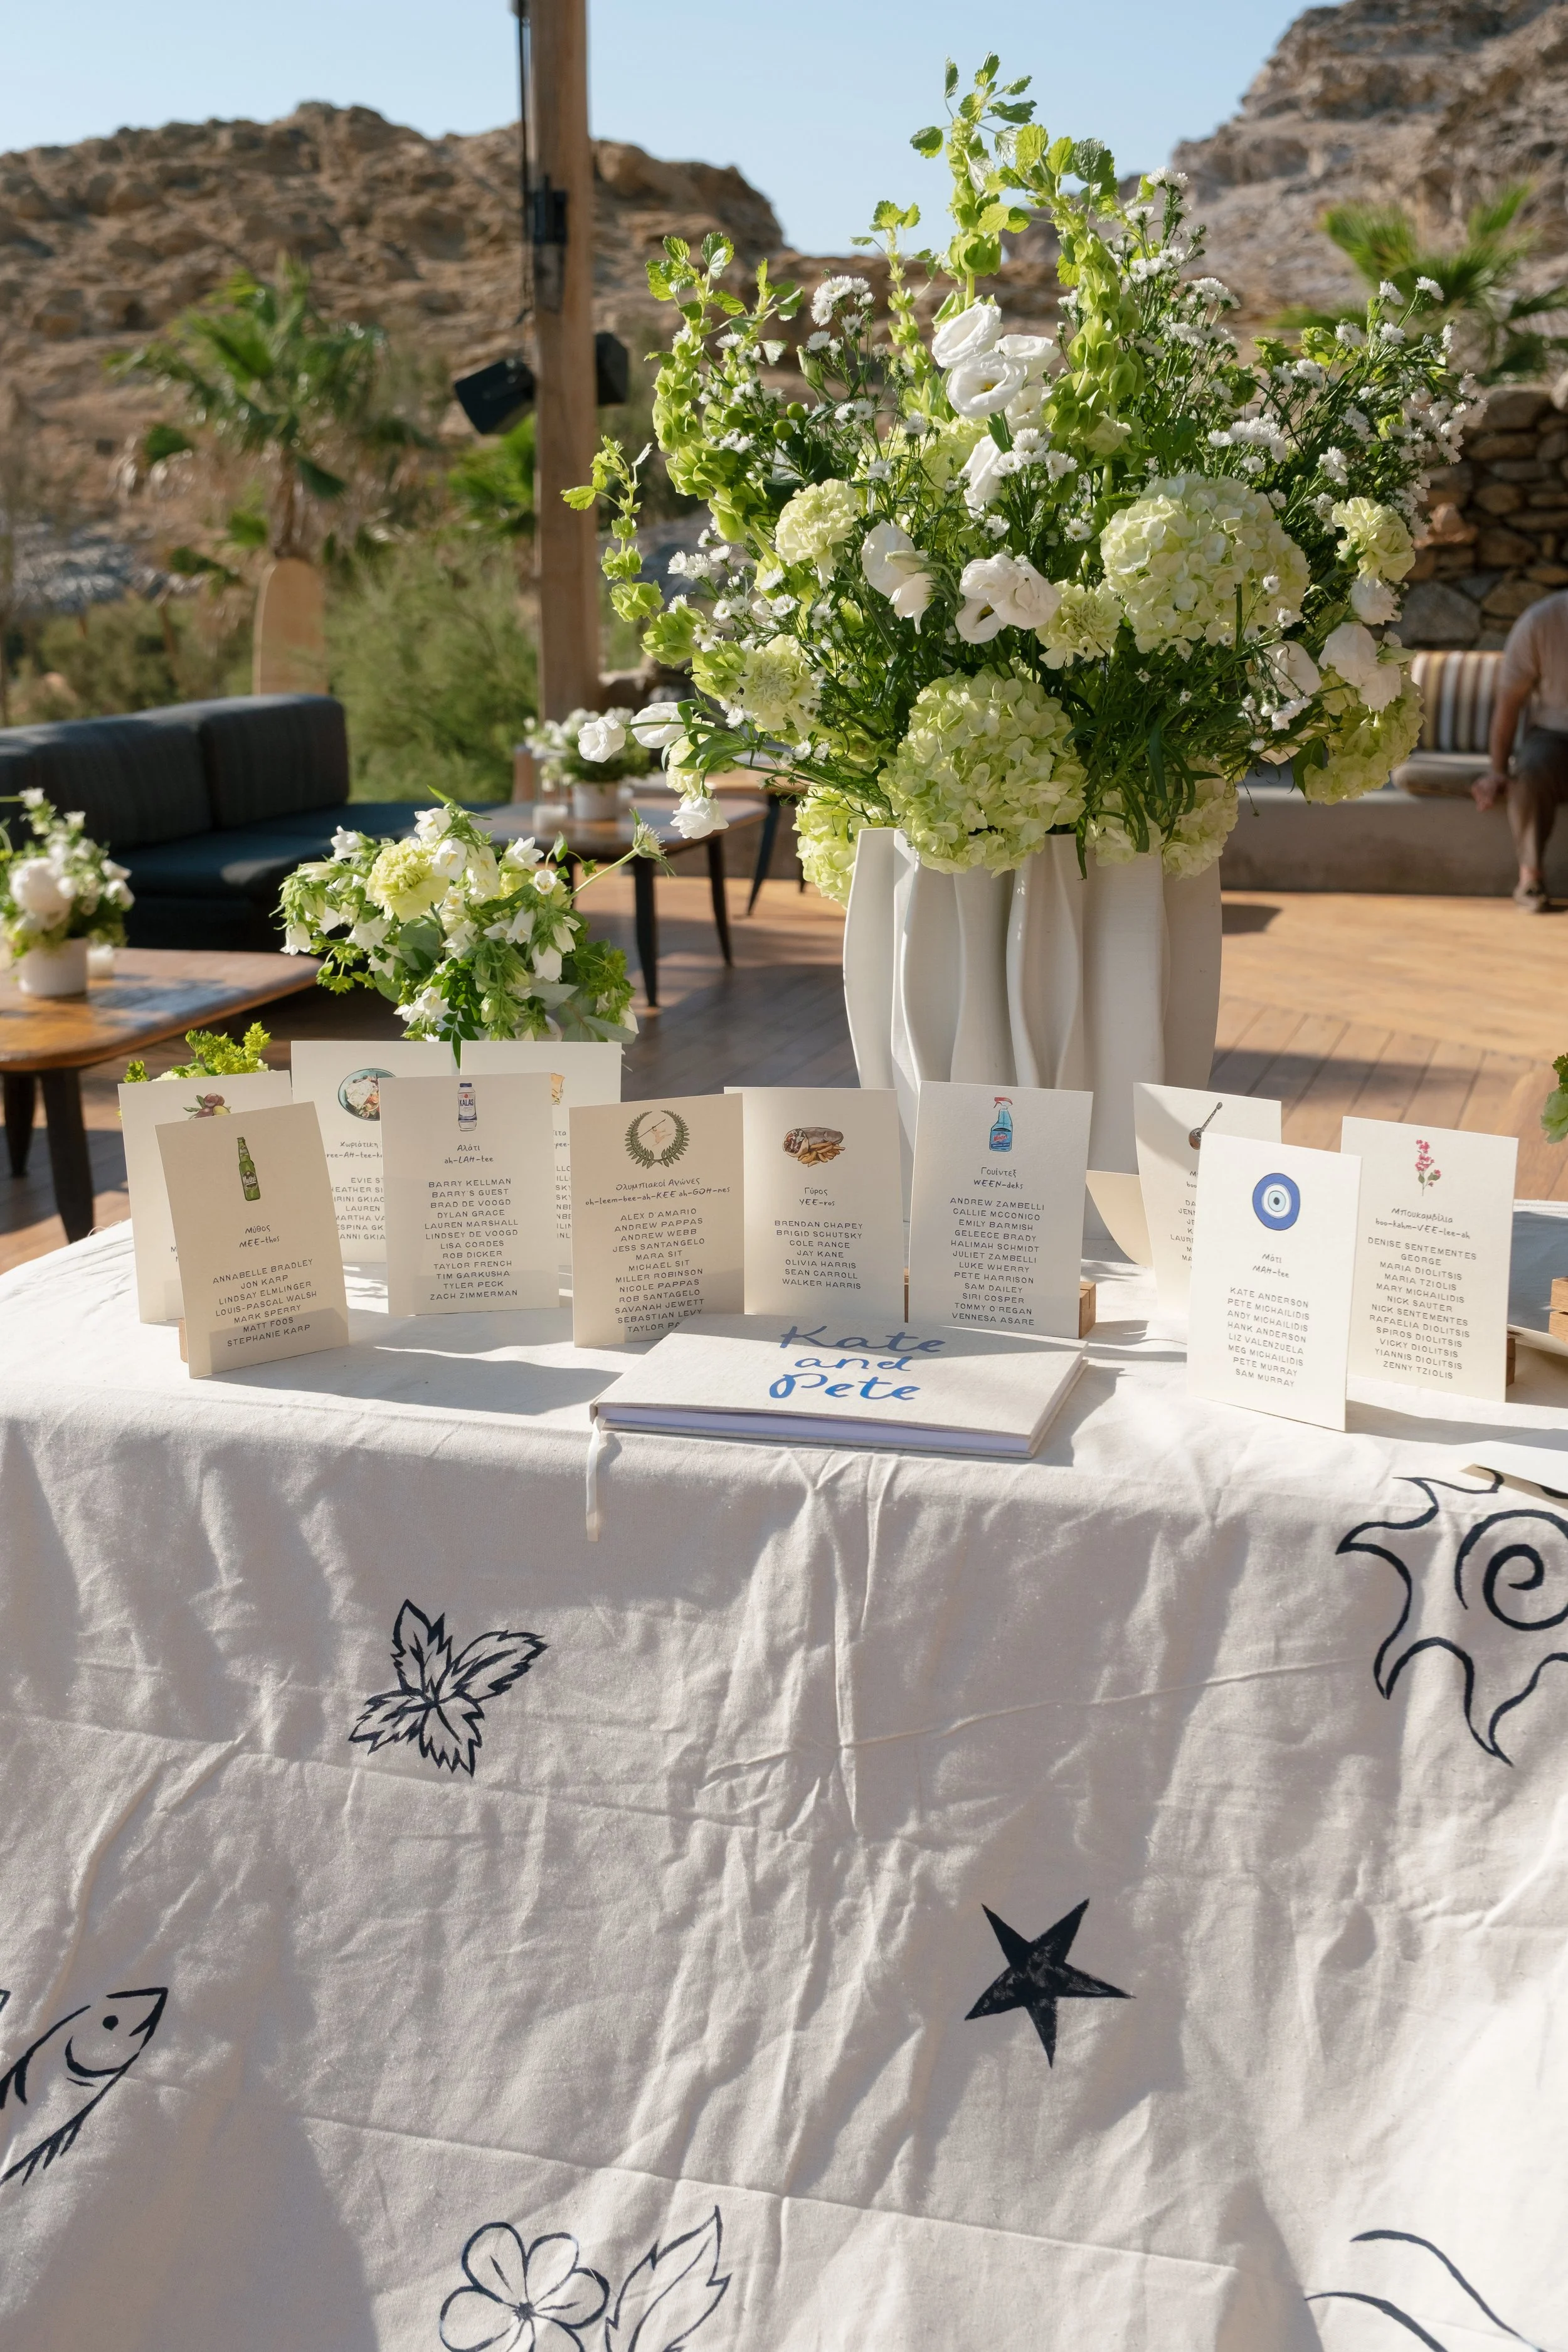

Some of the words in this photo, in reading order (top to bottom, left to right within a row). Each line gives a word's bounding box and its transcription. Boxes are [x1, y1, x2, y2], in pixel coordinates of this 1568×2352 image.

[444, 1155, 494, 1164] ah-LAH-tee
[466, 1178, 511, 1186] KELLMAN
[973, 1179, 1023, 1189] WEEN-deks
[432, 1190, 475, 1198] BARRY'S
[950, 1197, 993, 1206] ANDREW
[996, 1200, 1044, 1210] ZAMBELLI
[620, 1213, 645, 1221] ALEX
[649, 1208, 696, 1218] D'AMARIO
[953, 1208, 987, 1216] CALLIE
[990, 1211, 1040, 1221] MCCONICO
[425, 1221, 462, 1229] LAUREN
[467, 1219, 518, 1227] MARSHALL
[615, 1222, 657, 1232] ANDREW
[661, 1217, 702, 1227] PAPPAS
[989, 1221, 1033, 1231] BARMISH
[621, 1232, 664, 1242] ANDREW
[667, 1229, 697, 1237] WEBB
[813, 1231, 862, 1239] SCHUTSKY
[955, 1229, 999, 1239] GELEECE
[1003, 1233, 1036, 1242] BRADY
[239, 1236, 280, 1248] MEE-thos
[465, 1240, 504, 1248] CORDES
[613, 1244, 637, 1253] JESS
[640, 1238, 704, 1250] SANTANGELO
[1368, 1237, 1401, 1248] DENISE
[1405, 1242, 1476, 1260] SENTEMENTES
[636, 1253, 664, 1261] MARA
[953, 1251, 985, 1259] JULIET
[988, 1253, 1036, 1263] ZAMBELLI
[1401, 1254, 1441, 1266] GEORGE
[213, 1268, 268, 1284] ANNABELLE
[271, 1259, 312, 1273] BRADLEY
[628, 1262, 672, 1271] MICHAEL
[820, 1261, 856, 1269] HARRIS
[959, 1261, 983, 1269] LUKE
[987, 1264, 1029, 1273] WHERRY
[1380, 1261, 1411, 1272] MARIA
[1415, 1267, 1462, 1280] DIOLITSIS
[456, 1271, 510, 1279] GARKUSHA
[616, 1274, 650, 1283] MILLER
[654, 1268, 702, 1279] ROBINSON
[813, 1270, 857, 1279] CARROLL
[954, 1271, 980, 1279] PETE
[984, 1274, 1034, 1284] HARRISON
[1253, 1266, 1289, 1278] MAH-tee
[241, 1280, 258, 1290] JON
[261, 1274, 288, 1285] KARP
[620, 1283, 654, 1293] NICOLE
[658, 1279, 699, 1289] PAPPAS
[782, 1278, 822, 1286] WALKER
[826, 1281, 861, 1290] HARRIS
[1385, 1273, 1416, 1285] MARIA
[1419, 1279, 1456, 1291] TZIOLIS
[219, 1291, 257, 1305] LINDSAY
[260, 1281, 311, 1297] ELMLINGER
[460, 1290, 517, 1299] ZIMMERMAN
[643, 1289, 700, 1301] SANTAGELO
[988, 1285, 1022, 1293] DAILEY
[1376, 1283, 1402, 1293] MARY
[1406, 1288, 1465, 1303] MICHAILIDIS
[216, 1298, 283, 1316] LOUIS-PASCAL
[286, 1291, 317, 1302] WALSH
[984, 1295, 1024, 1304] COSPER
[1230, 1287, 1255, 1298] KATE
[1258, 1293, 1308, 1308] ANDERSON
[1387, 1296, 1409, 1305] NICK
[1412, 1300, 1452, 1312] SAUTER
[615, 1303, 662, 1314] SAVANAH
[665, 1298, 704, 1308] JEWETT
[955, 1303, 985, 1311] TOMMY
[989, 1305, 1032, 1315] O'REGAN
[1227, 1298, 1252, 1309] PETE
[1255, 1303, 1310, 1320] MICHAILIDIS
[234, 1313, 261, 1323] MARK
[264, 1305, 300, 1318] SPERRY
[618, 1311, 674, 1323] SEBASTIAN
[678, 1309, 702, 1317] LEVY
[952, 1313, 997, 1322] VENNESA
[1000, 1317, 1034, 1325] ASARE
[1372, 1304, 1393, 1314] NICK
[1397, 1308, 1468, 1326] SENTEMENTES
[243, 1322, 267, 1333] MATT
[270, 1316, 294, 1327] FOOS
[627, 1323, 665, 1332] TAYLOR
[227, 1330, 280, 1347] STEPHANIE
[283, 1324, 310, 1335] KARP
[779, 1325, 946, 1352] Kate
[1228, 1321, 1253, 1332] HANK
[1256, 1327, 1306, 1343] ANDERSON
[1229, 1333, 1242, 1342] LIZ
[1245, 1336, 1304, 1354] VALENZUELA
[1380, 1338, 1407, 1348] VICKY
[1411, 1343, 1458, 1358] DIOLITSIS
[1228, 1344, 1246, 1354] MEG
[1249, 1348, 1303, 1366] MICHAILIDIS
[1375, 1348, 1412, 1360] YIANNIS
[1416, 1355, 1462, 1370] DIOLITSIS
[794, 1355, 914, 1372] and
[1233, 1357, 1257, 1368] PETE
[1261, 1362, 1297, 1376] MURRAY
[1383, 1360, 1412, 1371] ZENNY
[1416, 1367, 1453, 1379] TZIOLIS
[1236, 1369, 1254, 1378] SAM
[1258, 1374, 1295, 1386] MURRAY
[769, 1373, 921, 1401] Pete
